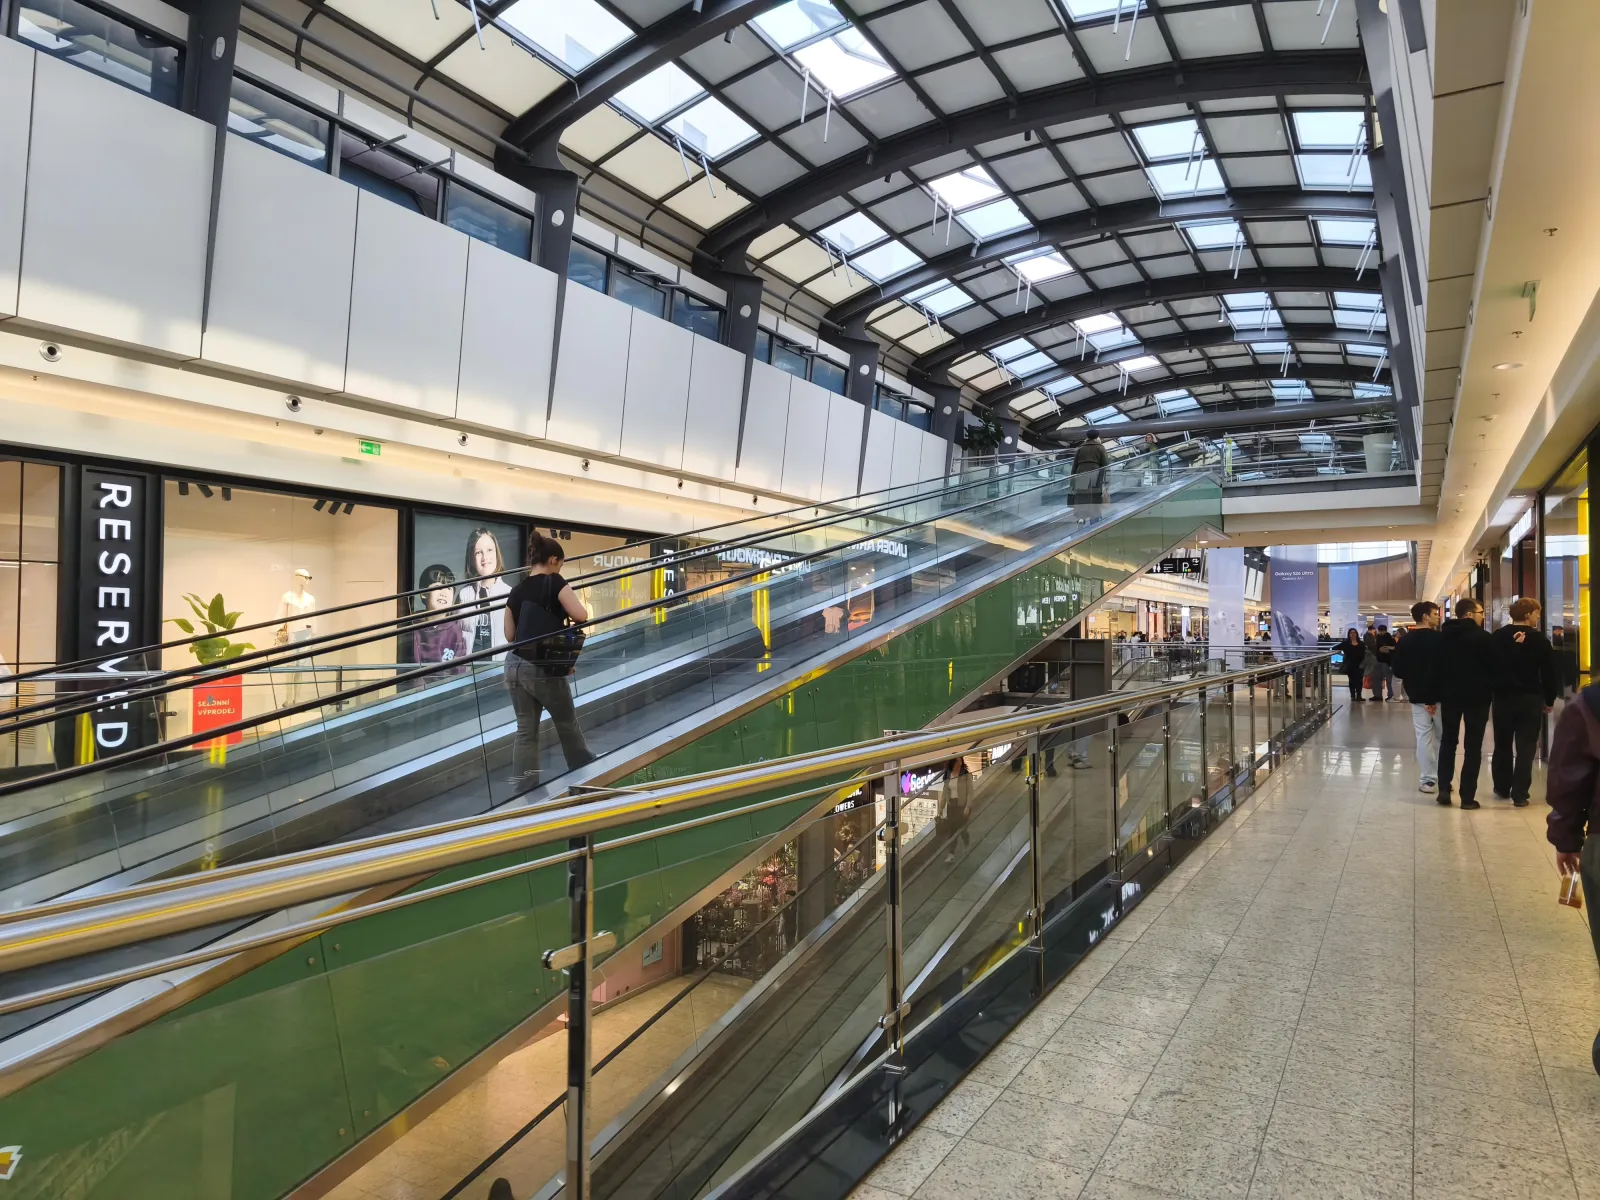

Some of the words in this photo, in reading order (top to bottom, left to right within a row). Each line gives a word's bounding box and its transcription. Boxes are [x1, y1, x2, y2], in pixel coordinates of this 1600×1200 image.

[95, 481, 133, 749] RESERVED
[197, 708, 236, 716] VÝPRODEJ
[910, 769, 937, 791] Servi
[833, 800, 855, 813] OWERS
